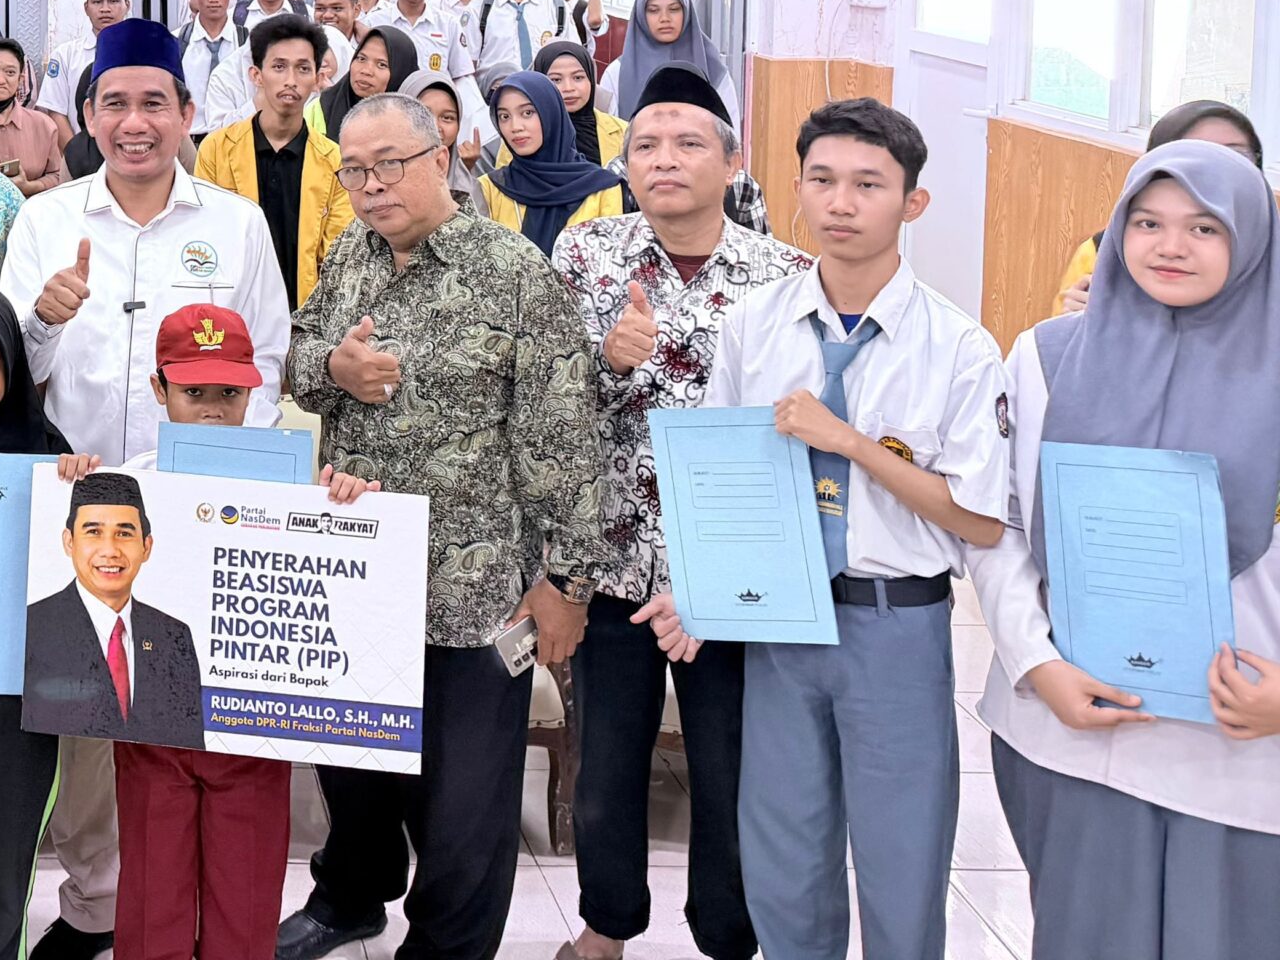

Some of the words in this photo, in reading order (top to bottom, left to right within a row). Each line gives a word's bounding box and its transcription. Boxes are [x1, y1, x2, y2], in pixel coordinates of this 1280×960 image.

[240, 513, 281, 525] NasDem
[241, 505, 266, 515] Partai
[291, 516, 319, 529] ANAK
[334, 520, 375, 534] RAKYAT
[213, 546, 367, 579] PENYERAHAN
[212, 569, 328, 599] BEASISWA
[212, 592, 330, 622] PROGRAM
[211, 615, 338, 646] INDONESIA
[210, 638, 291, 665] PINTAR
[297, 646, 349, 676] (PIP)
[209, 664, 258, 680] Aspirasi
[261, 670, 286, 682] dari
[290, 673, 329, 688] Bapak
[210, 713, 254, 728] Anggota
[256, 717, 290, 730] DPR-RI
[292, 720, 323, 733] Fraksi
[325, 724, 356, 737] Partai
[358, 727, 400, 741] NasDem
[211, 695, 287, 716] RUDIANTO
[289, 703, 340, 723] LALLO,
[344, 708, 378, 727] S.H.,
[381, 713, 415, 730] M.H.
